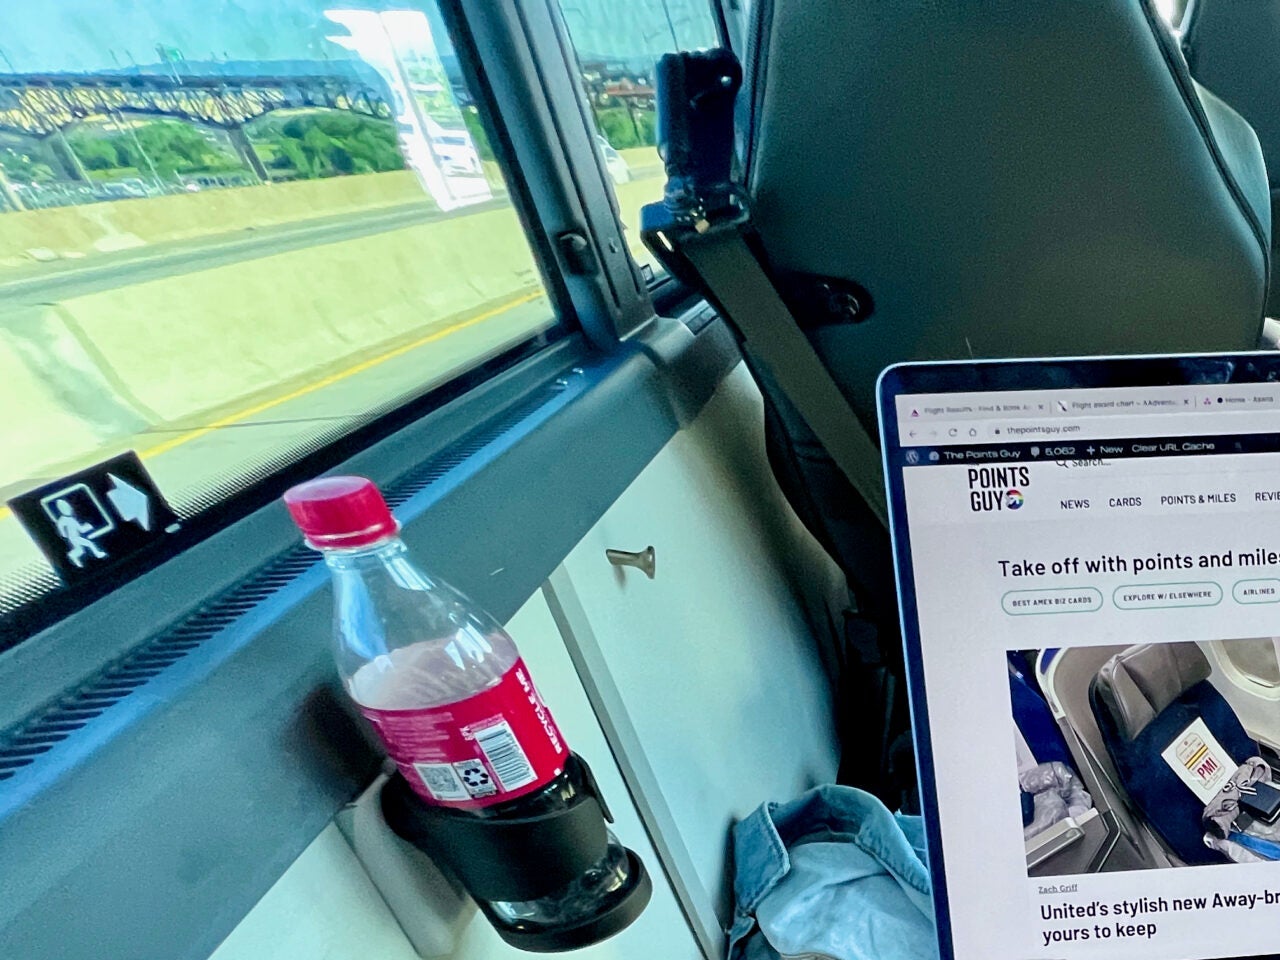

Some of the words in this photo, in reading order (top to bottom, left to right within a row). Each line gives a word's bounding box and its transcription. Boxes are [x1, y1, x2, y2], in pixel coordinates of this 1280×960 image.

[1100, 446, 1123, 454] New
[1131, 444, 1157, 452] Clear
[1159, 443, 1180, 451] URL
[1182, 442, 1215, 451] Cache
[943, 451, 964, 459] The
[966, 450, 997, 459] Points
[1000, 449, 1021, 460] Guy
[967, 466, 1030, 489] POINTS
[971, 490, 1003, 512] GUY
[1060, 499, 1090, 510] NEWS
[1109, 497, 1142, 508] CARDS
[1160, 495, 1196, 505] POINTS
[1207, 493, 1237, 503] MILES
[998, 560, 1046, 577] Take
[1051, 557, 1080, 575] off
[1085, 555, 1127, 573] with
[1133, 553, 1194, 575] points
[1198, 550, 1233, 569] and
[1123, 594, 1155, 602] EXPLORE
[1169, 591, 1212, 600] ELSEWHERE
[1243, 588, 1276, 596] AIRLINES
[1012, 599, 1031, 607] BEST
[1068, 596, 1092, 605] CARDS
[1196, 757, 1219, 780] PMI
[1038, 885, 1058, 895] Zach
[1059, 884, 1078, 893] Griff
[1040, 901, 1109, 920] United's
[1113, 896, 1169, 918] stylish
[1172, 895, 1207, 911] new
[1042, 926, 1090, 947] yours
[1094, 924, 1111, 939] to
[1115, 922, 1157, 939] keep
